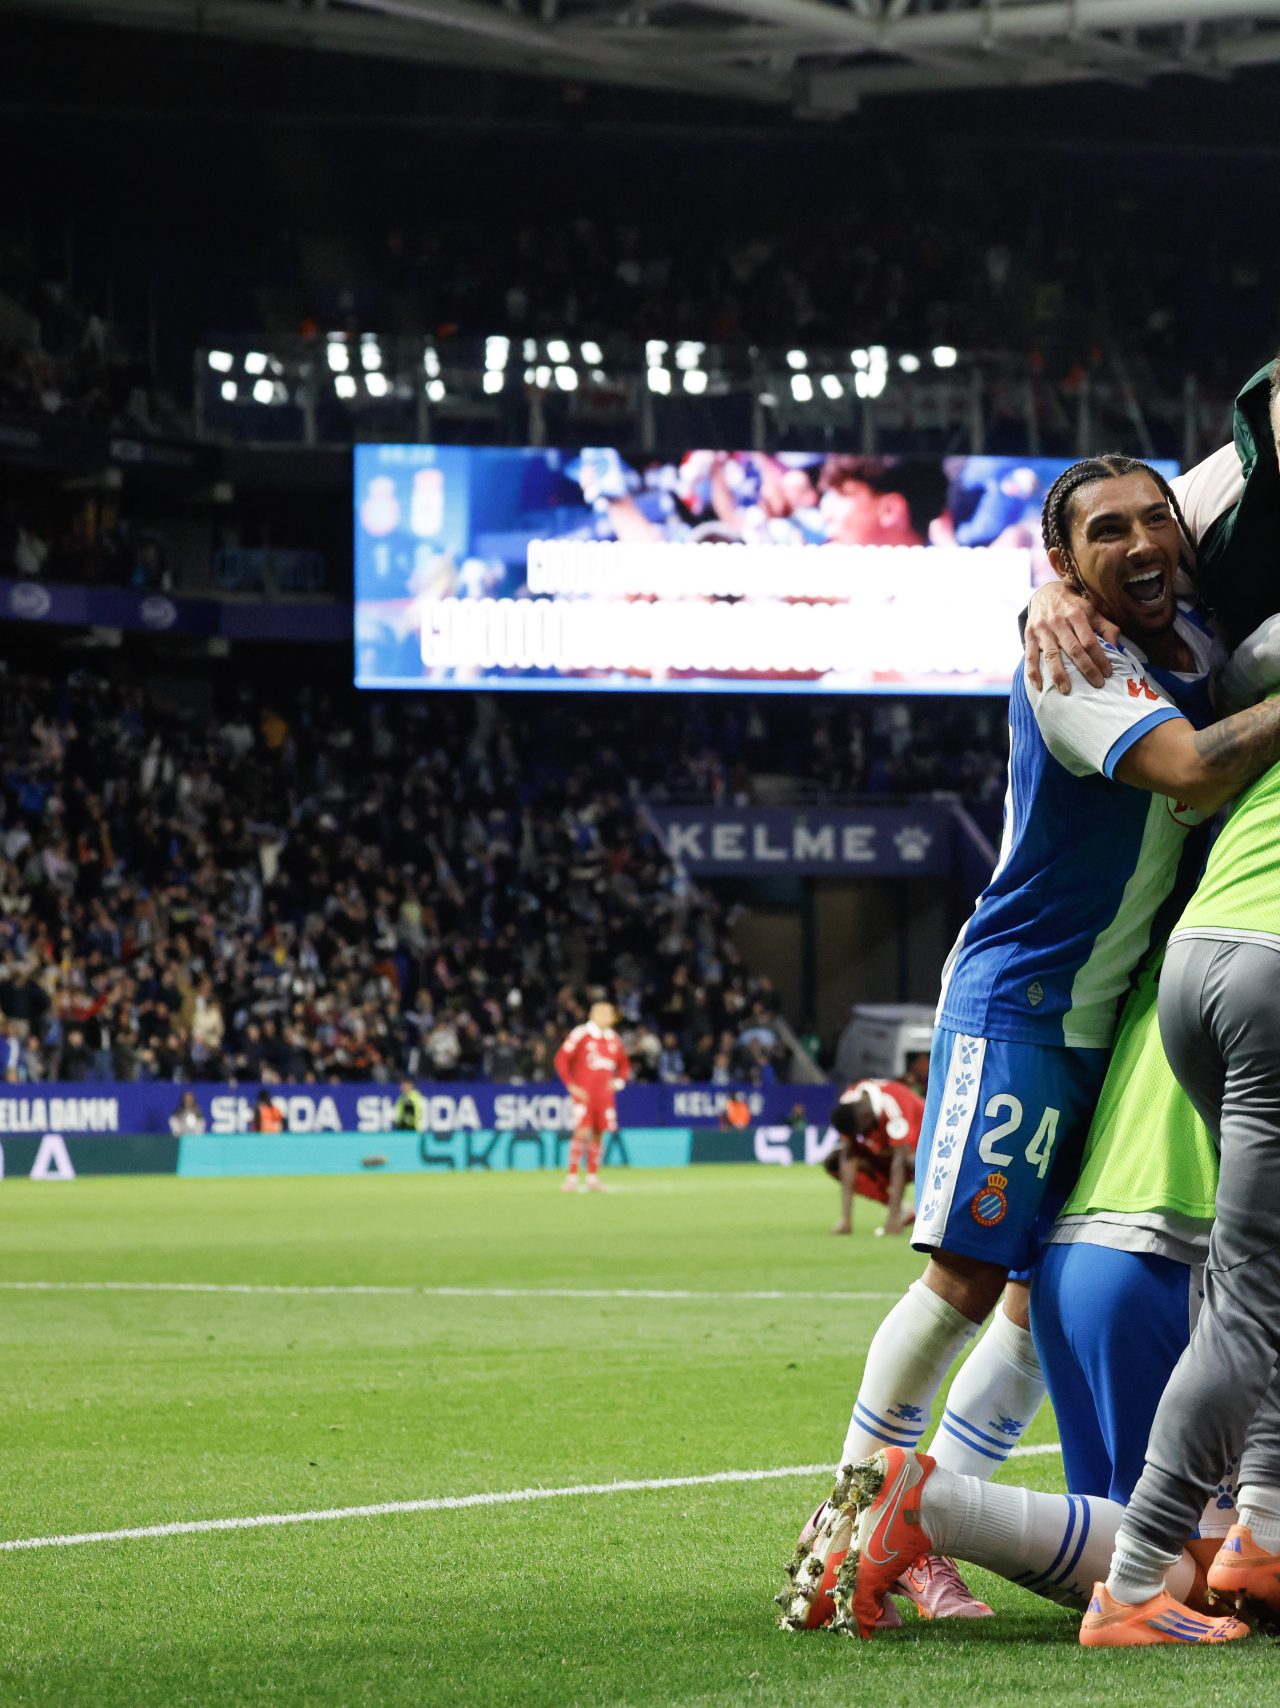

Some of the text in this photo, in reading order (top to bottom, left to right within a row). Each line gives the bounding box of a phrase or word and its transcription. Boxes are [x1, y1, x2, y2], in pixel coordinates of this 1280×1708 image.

[668, 823, 877, 862] KELME
[49, 1098, 119, 1132] DAMM
[210, 1096, 343, 1133] SKDA
[978, 1093, 1060, 1179] 24
